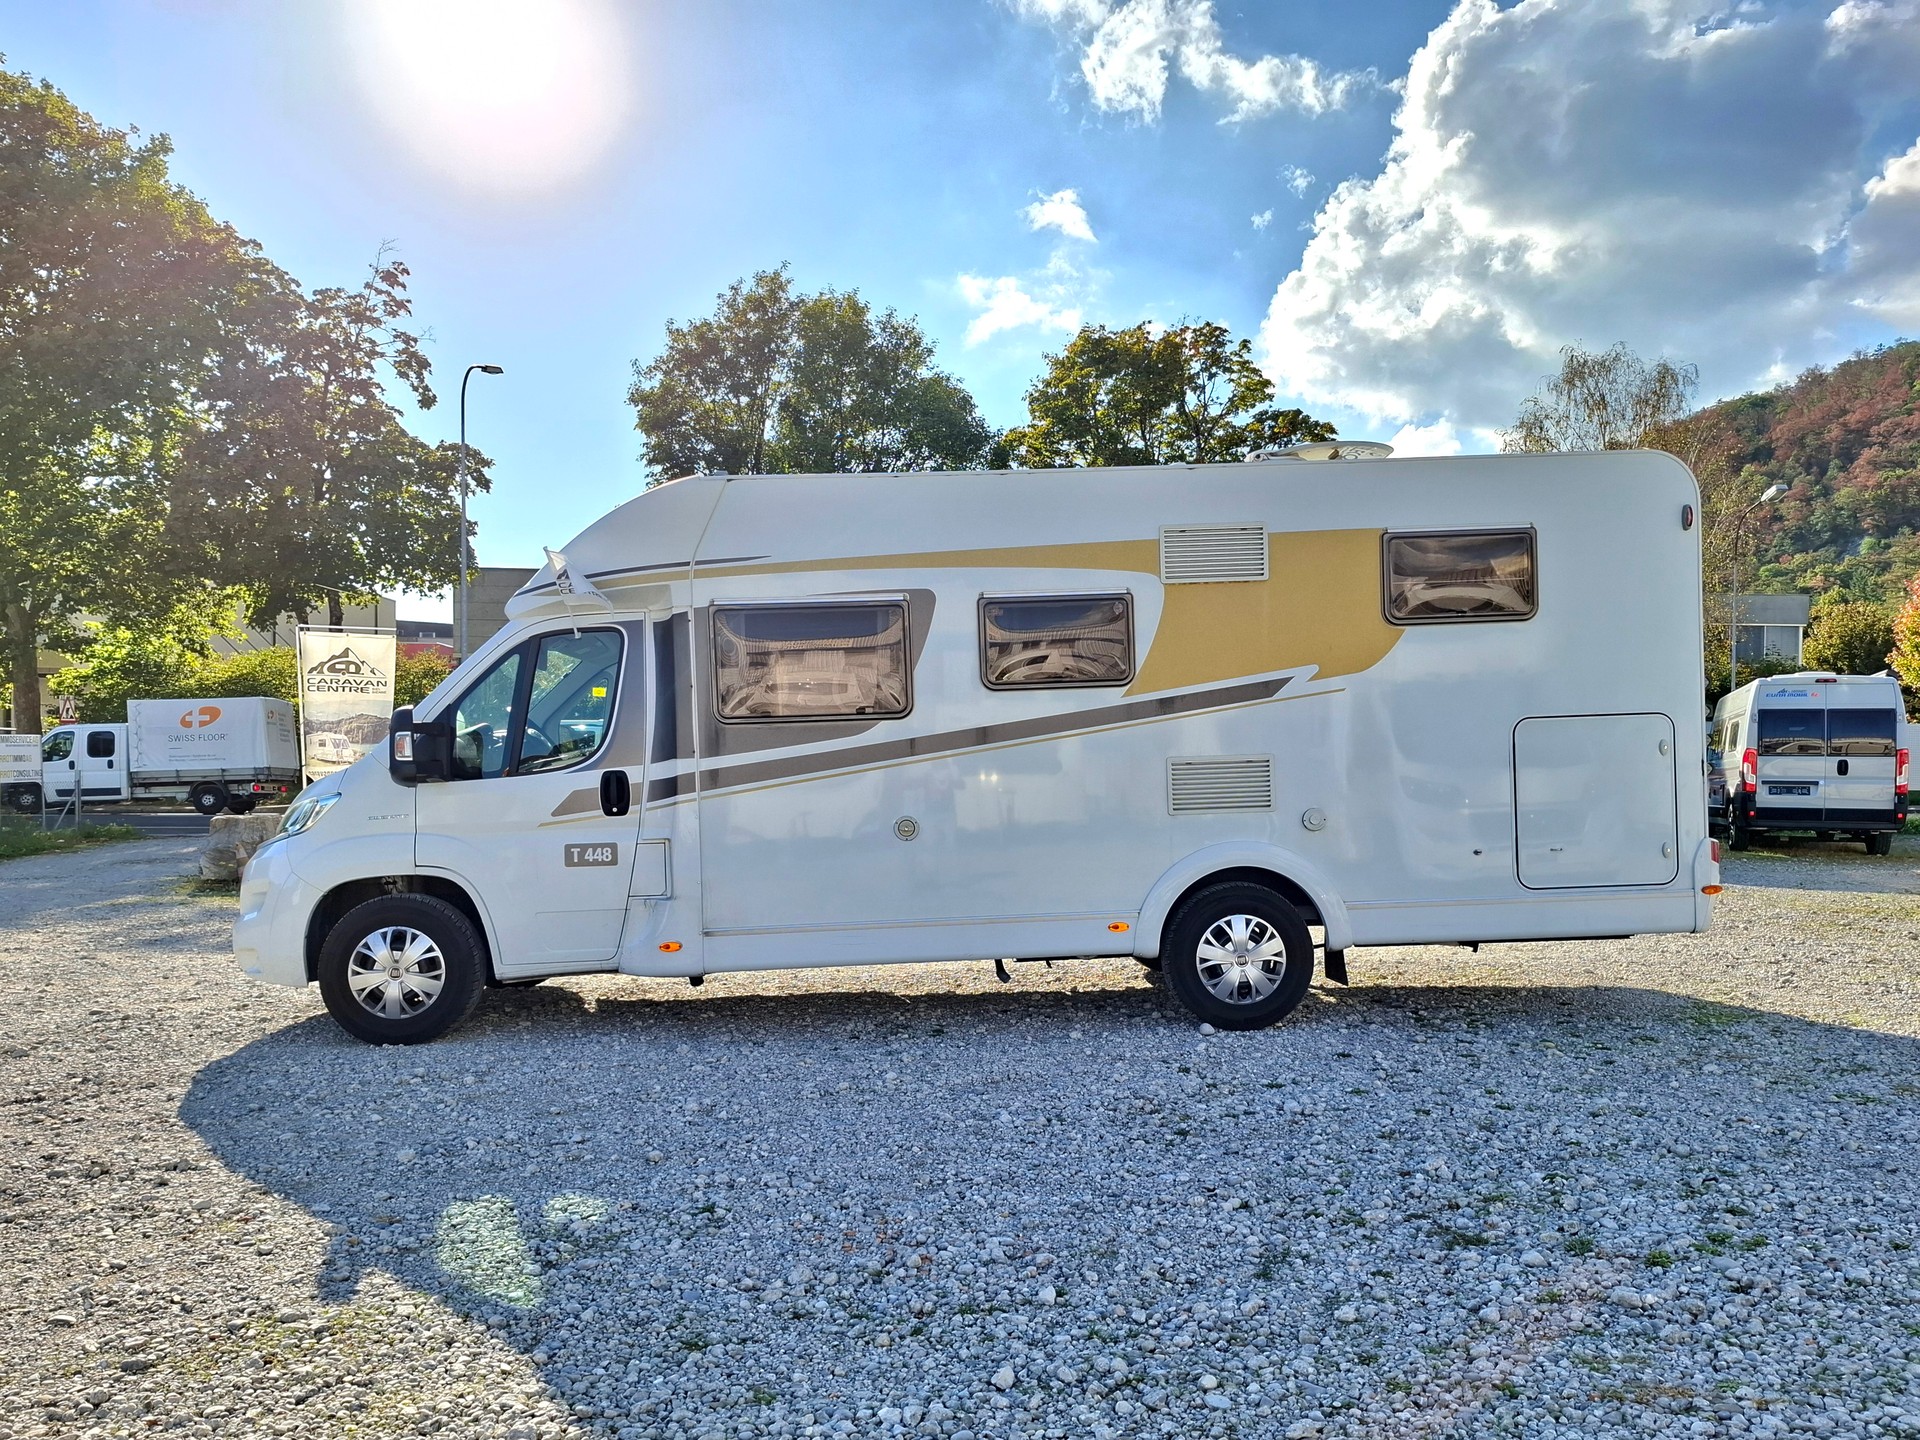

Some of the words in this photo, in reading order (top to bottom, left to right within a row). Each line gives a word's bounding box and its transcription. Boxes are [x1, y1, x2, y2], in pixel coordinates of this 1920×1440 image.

[307, 677, 387, 687] CARAVAN
[307, 685, 370, 694] CENTRE
[168, 734, 195, 742] SWISS
[570, 847, 581, 863] T
[584, 847, 612, 862] 448
